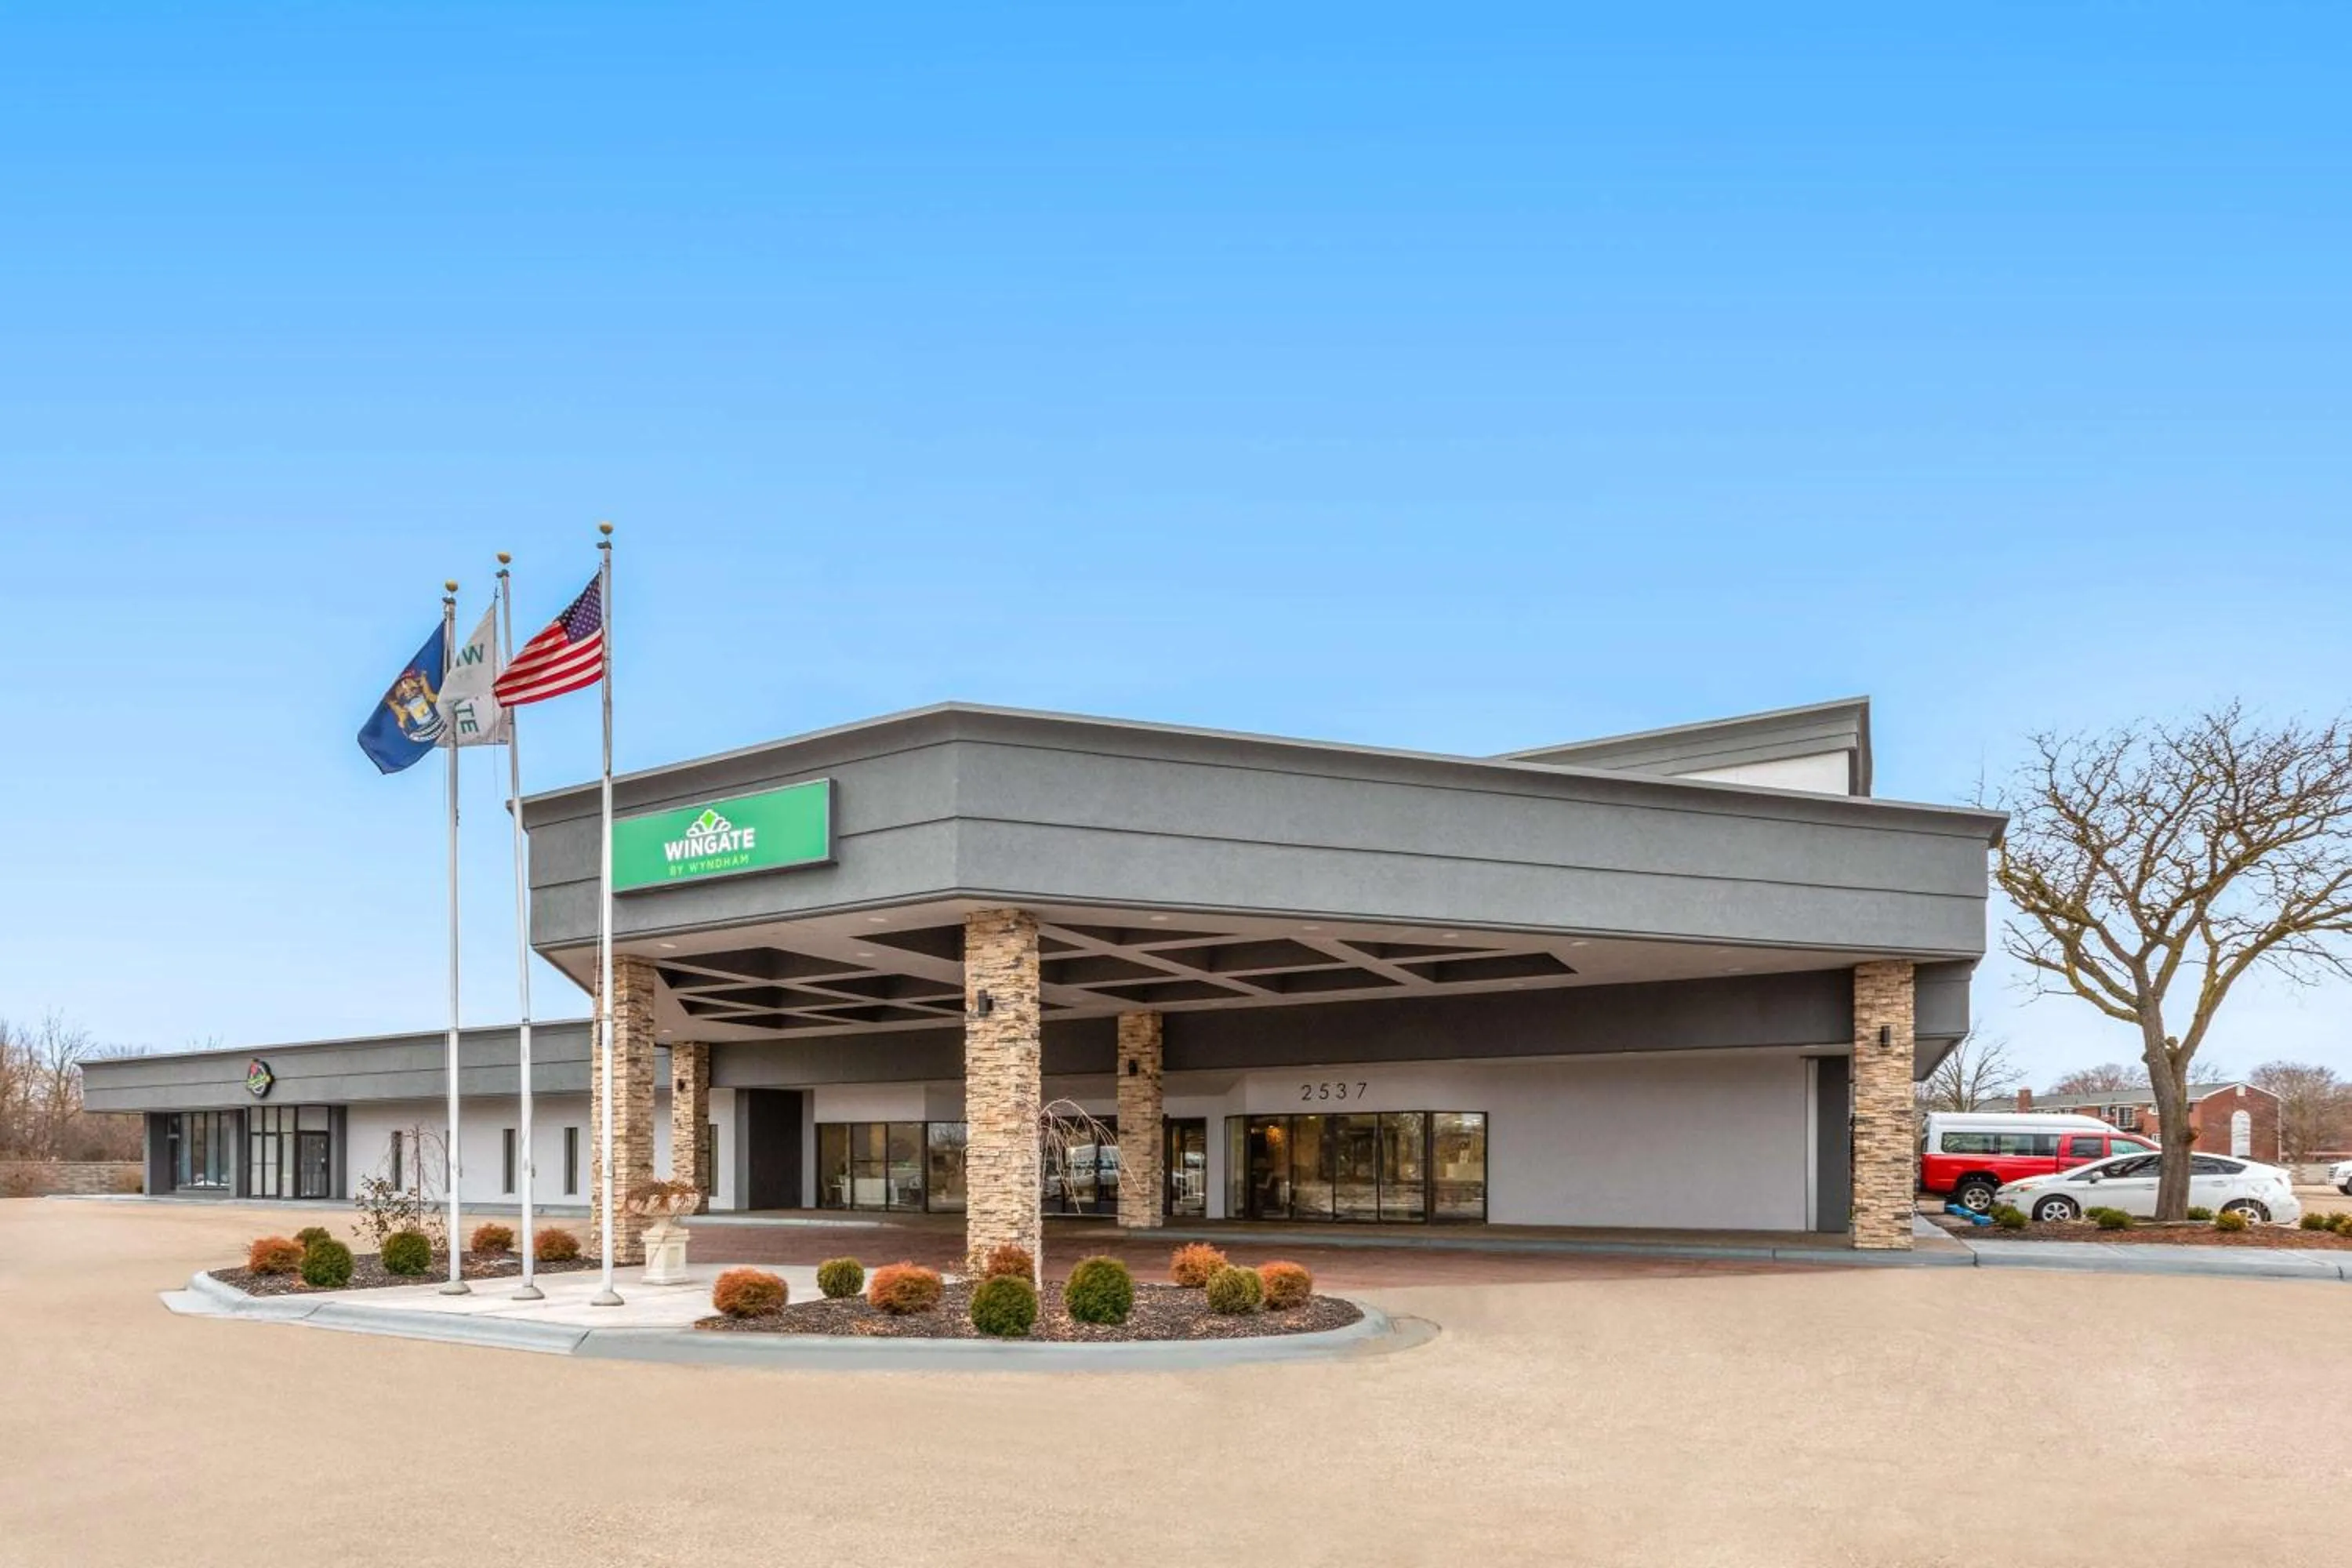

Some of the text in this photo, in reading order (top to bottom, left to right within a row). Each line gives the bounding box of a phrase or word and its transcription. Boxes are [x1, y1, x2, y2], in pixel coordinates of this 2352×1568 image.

[664, 827, 756, 861] WINGATE
[669, 853, 750, 877] BY WYNDHAM
[1301, 1082, 1367, 1102] 2537
